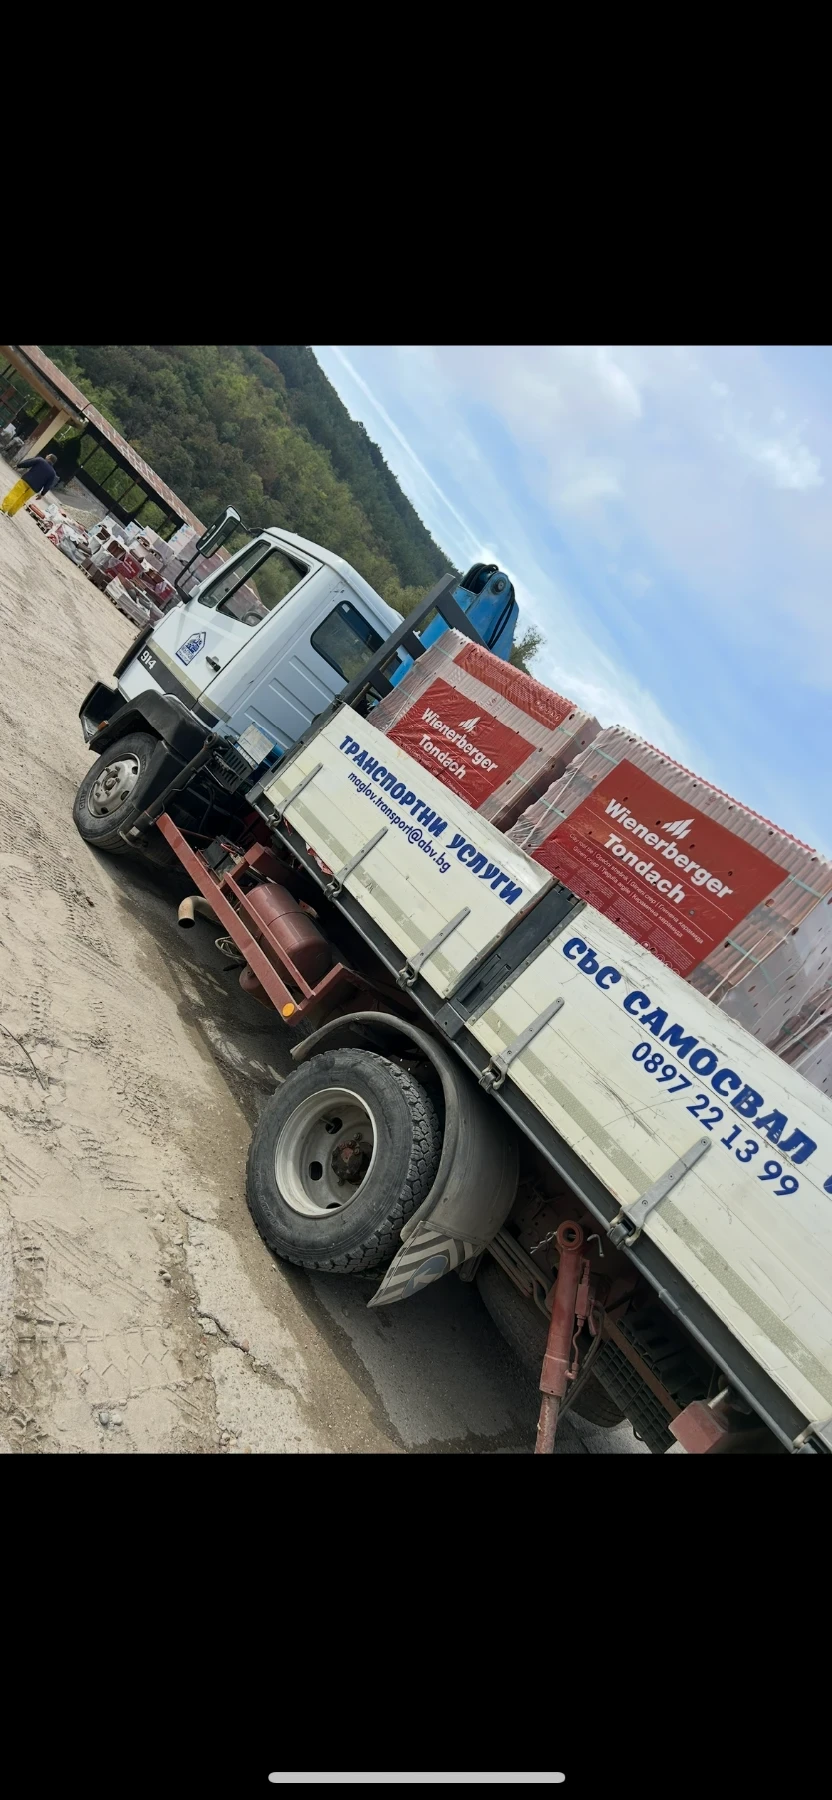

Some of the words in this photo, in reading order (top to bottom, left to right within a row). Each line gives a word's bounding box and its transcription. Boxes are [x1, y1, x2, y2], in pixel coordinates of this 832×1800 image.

[141, 650, 157, 670] 914
[419, 734, 466, 780] Tondach
[421, 708, 498, 773] Wienerberger
[339, 735, 448, 837] ТРАНСПОРТНИ
[446, 833, 523, 905] УСЛУГИ
[348, 771, 451, 873] maglov.transport@abv.bg
[603, 834, 686, 904] Tondach
[604, 798, 733, 899] Wienerberger
[623, 990, 818, 1165] САМОСВАЛ
[632, 1042, 692, 1094] 0897
[686, 1093, 724, 1131] 22
[720, 1124, 760, 1163] 13
[757, 1160, 800, 1198] 99
